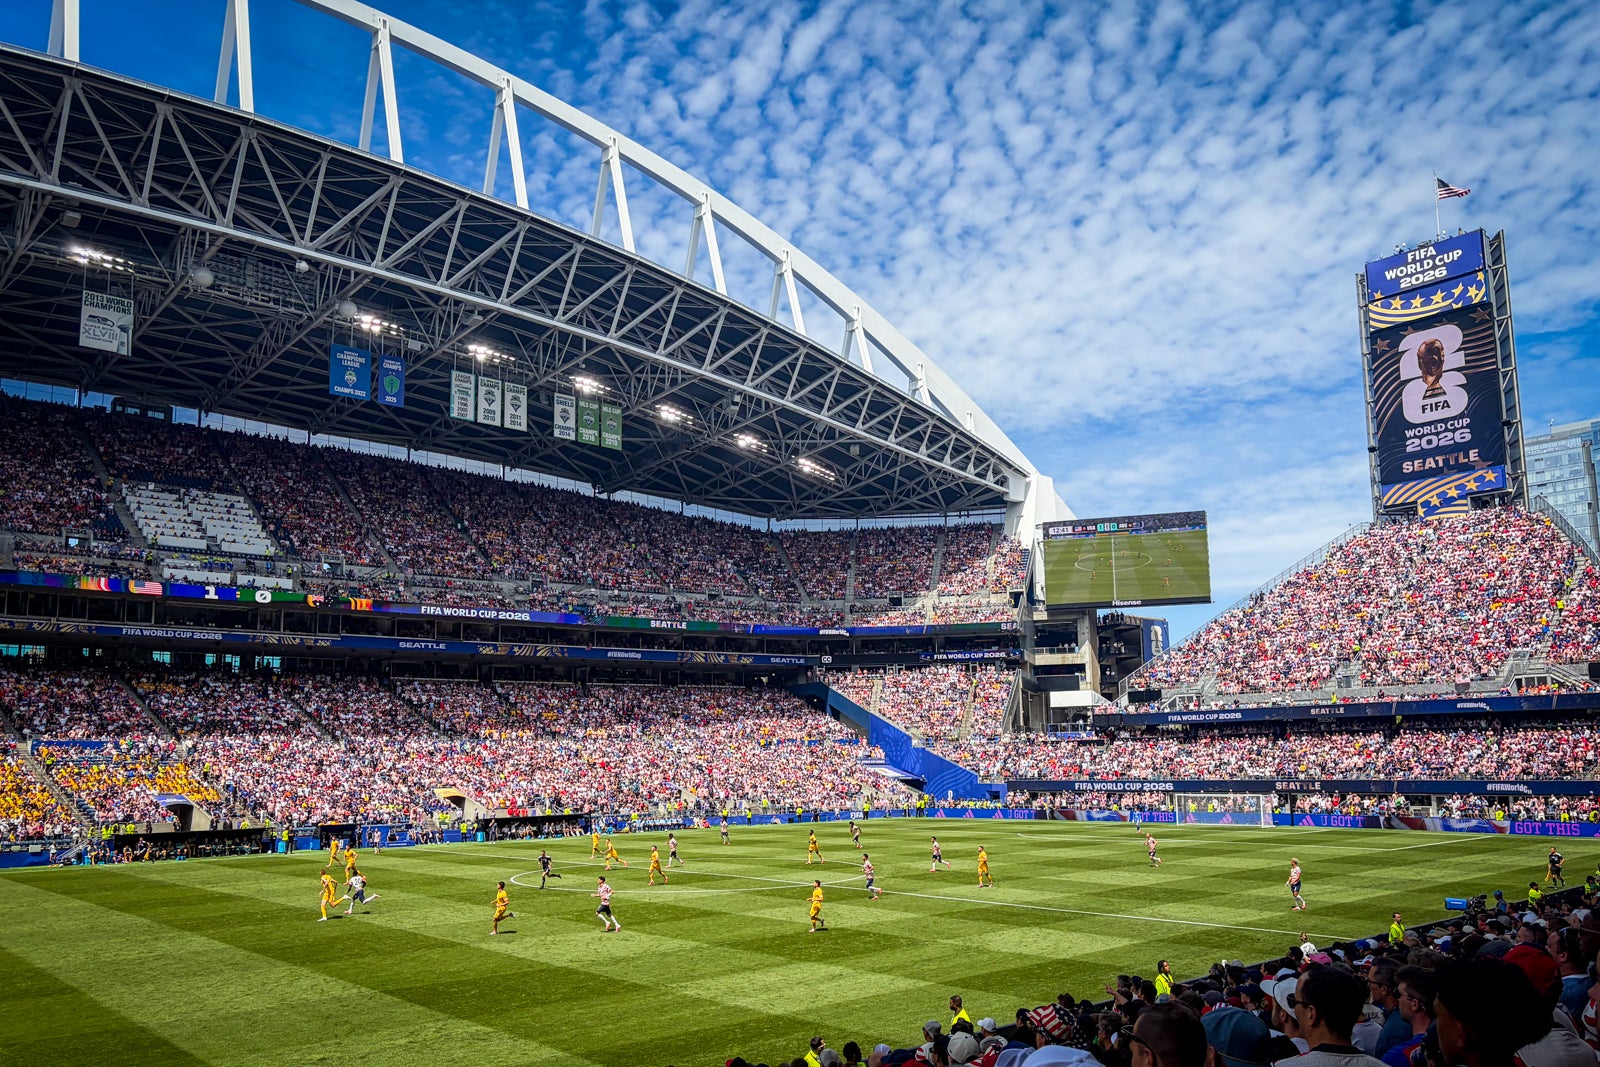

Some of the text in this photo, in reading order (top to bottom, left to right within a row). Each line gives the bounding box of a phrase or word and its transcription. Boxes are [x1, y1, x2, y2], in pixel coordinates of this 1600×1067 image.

[1407, 246, 1436, 262] FIFA
[1384, 249, 1462, 280] WORLD CUP
[1400, 266, 1448, 288] 2026
[84, 292, 132, 308] 2013 WORLD
[84, 300, 132, 315] CHAMPIONS
[337, 353, 366, 363] CHAMPIONS
[342, 360, 360, 368] LEAGUE
[556, 399, 574, 408] SHIELD
[1422, 400, 1451, 414] FIFA
[1405, 418, 1470, 438] WORLD CUP
[1406, 428, 1472, 452] 2026
[1402, 448, 1479, 474] SEATTLE
[204, 586, 218, 600] 1
[421, 606, 530, 621] FIFA WORLD CUP 2026
[650, 620, 687, 629] SEATTLE
[142, 630, 174, 638] WORLD
[399, 641, 446, 649] SEATTLE
[607, 651, 641, 659] #FIFAWorldCup
[1275, 782, 1320, 790] SEATTLE
[1014, 810, 1028, 818] GOT
[1152, 812, 1174, 822] THIS
[1321, 816, 1364, 827] U GOT T
[1515, 822, 1580, 836] GOT THIS
